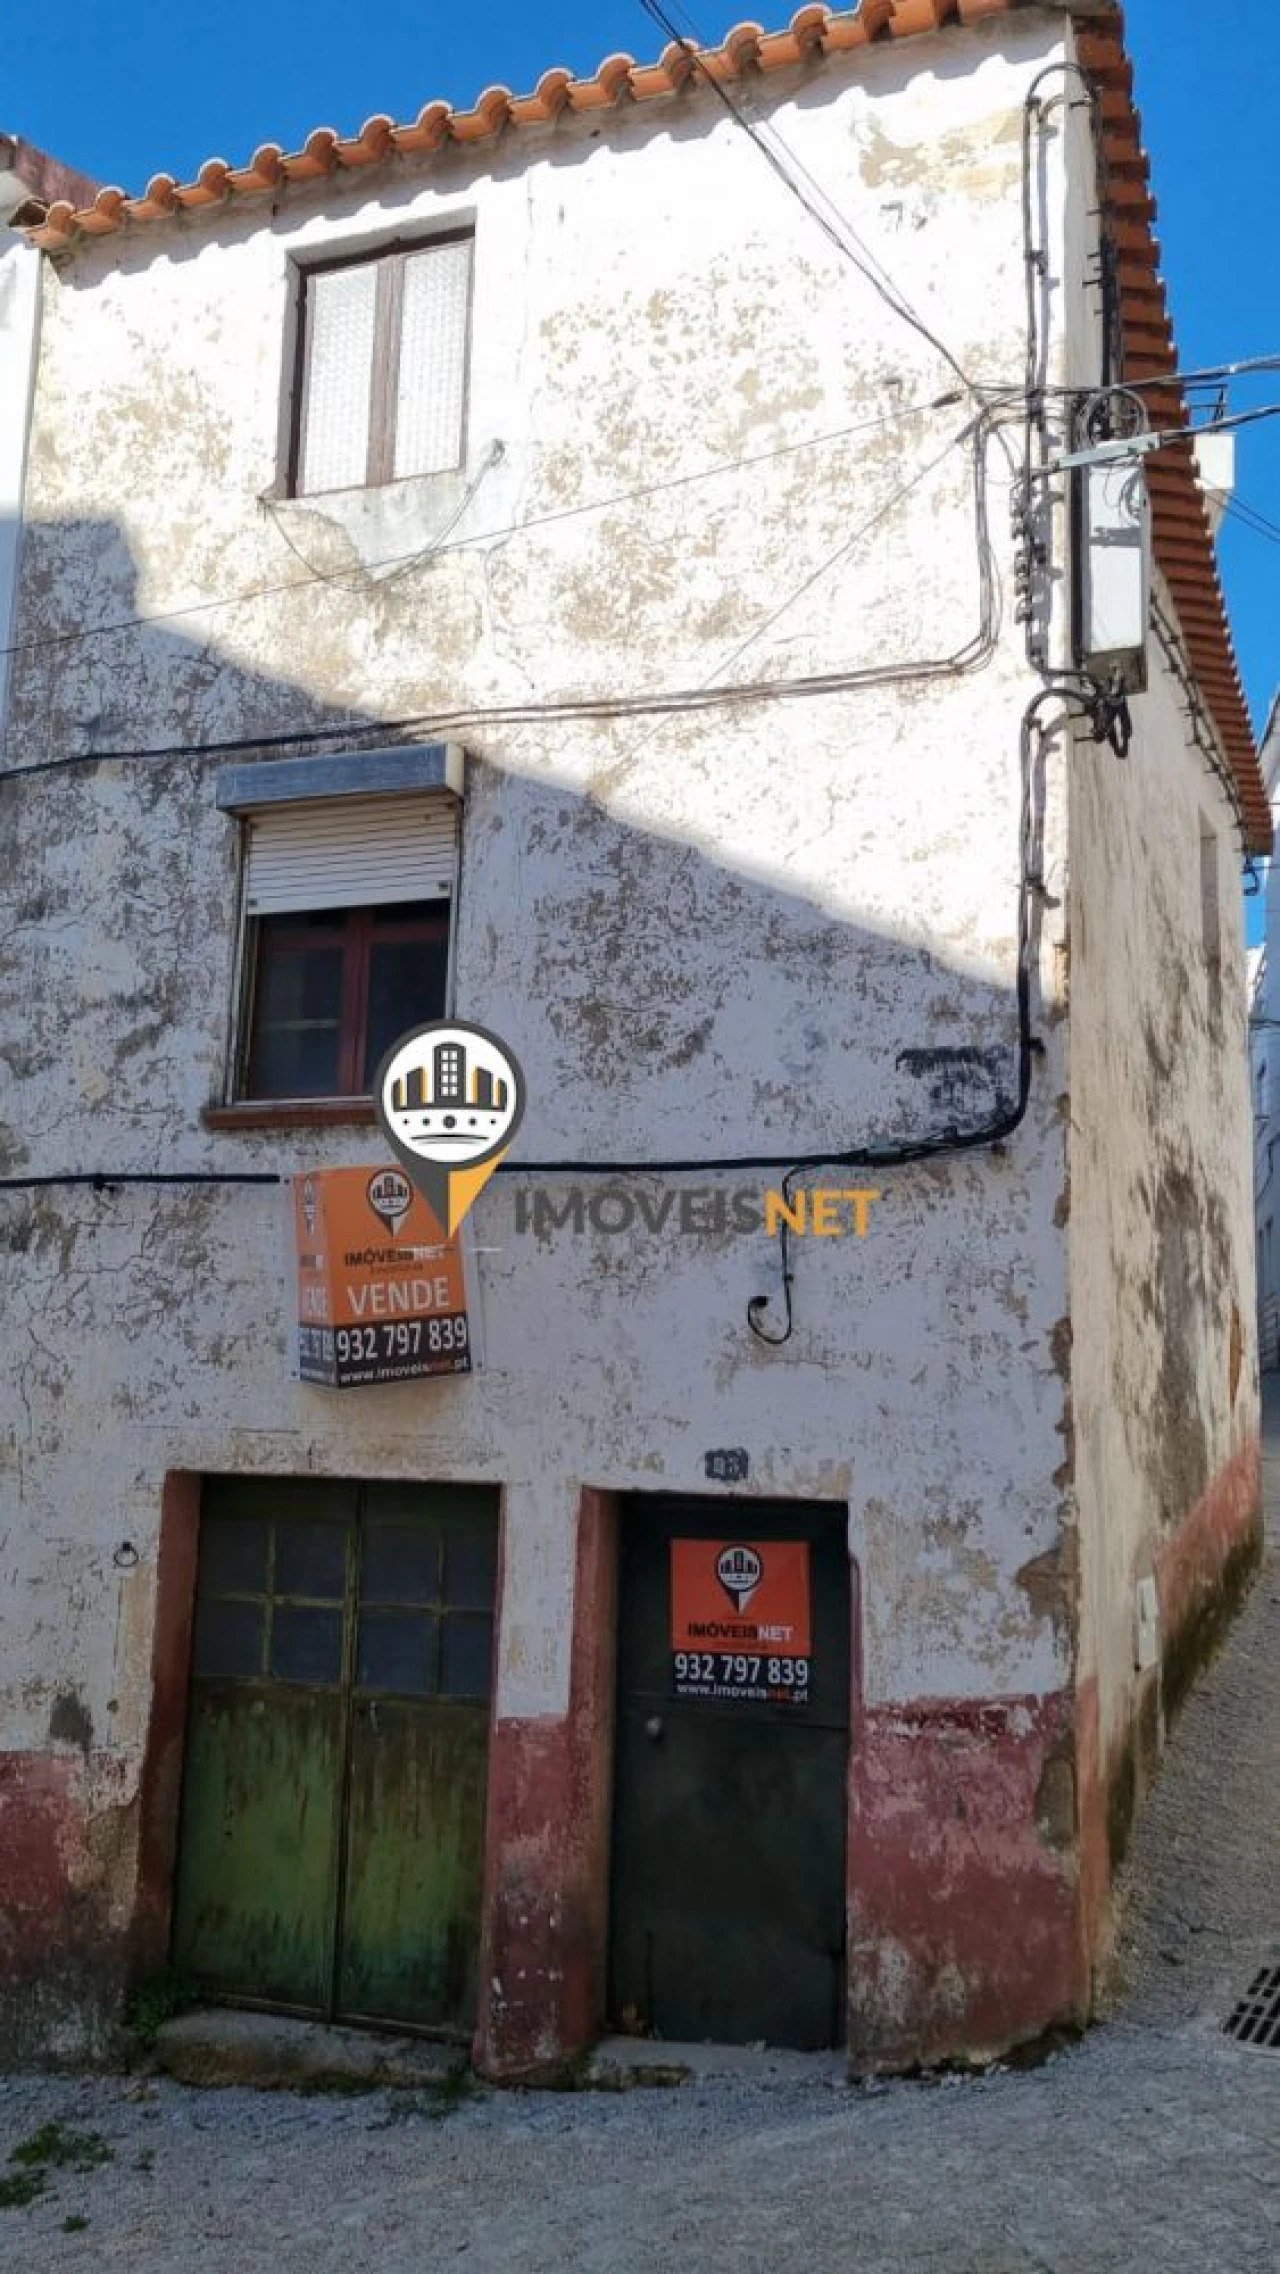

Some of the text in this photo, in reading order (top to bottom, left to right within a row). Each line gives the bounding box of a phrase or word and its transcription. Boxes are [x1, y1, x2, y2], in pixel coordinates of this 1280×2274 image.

[347, 1277, 449, 1315] VENDE
[338, 1327, 378, 1363] 932
[382, 1322, 422, 1357] 797
[429, 1316, 467, 1350] 839
[675, 1652, 808, 1687] 932 797 839
